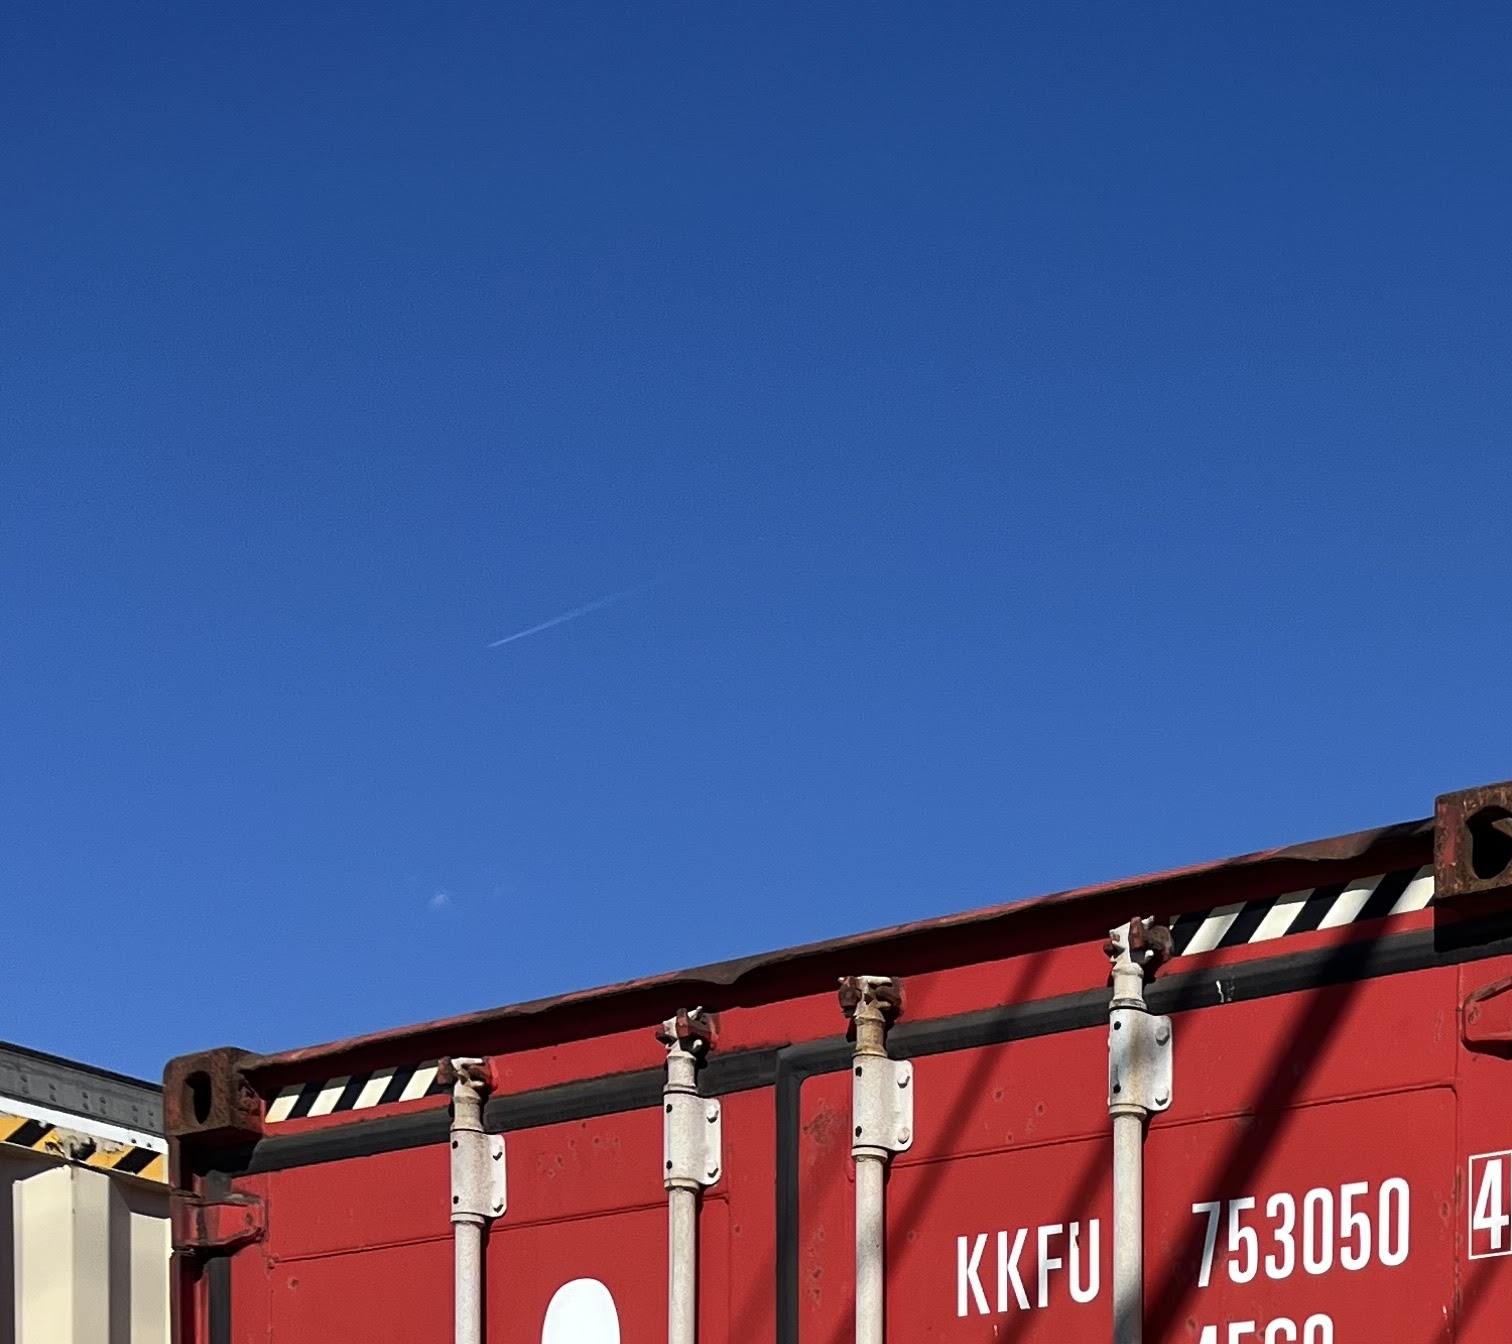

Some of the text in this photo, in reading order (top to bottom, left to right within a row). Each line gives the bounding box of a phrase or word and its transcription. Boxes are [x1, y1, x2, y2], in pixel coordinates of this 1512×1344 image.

[958, 1158, 1509, 1317] KKFU 753050 4
